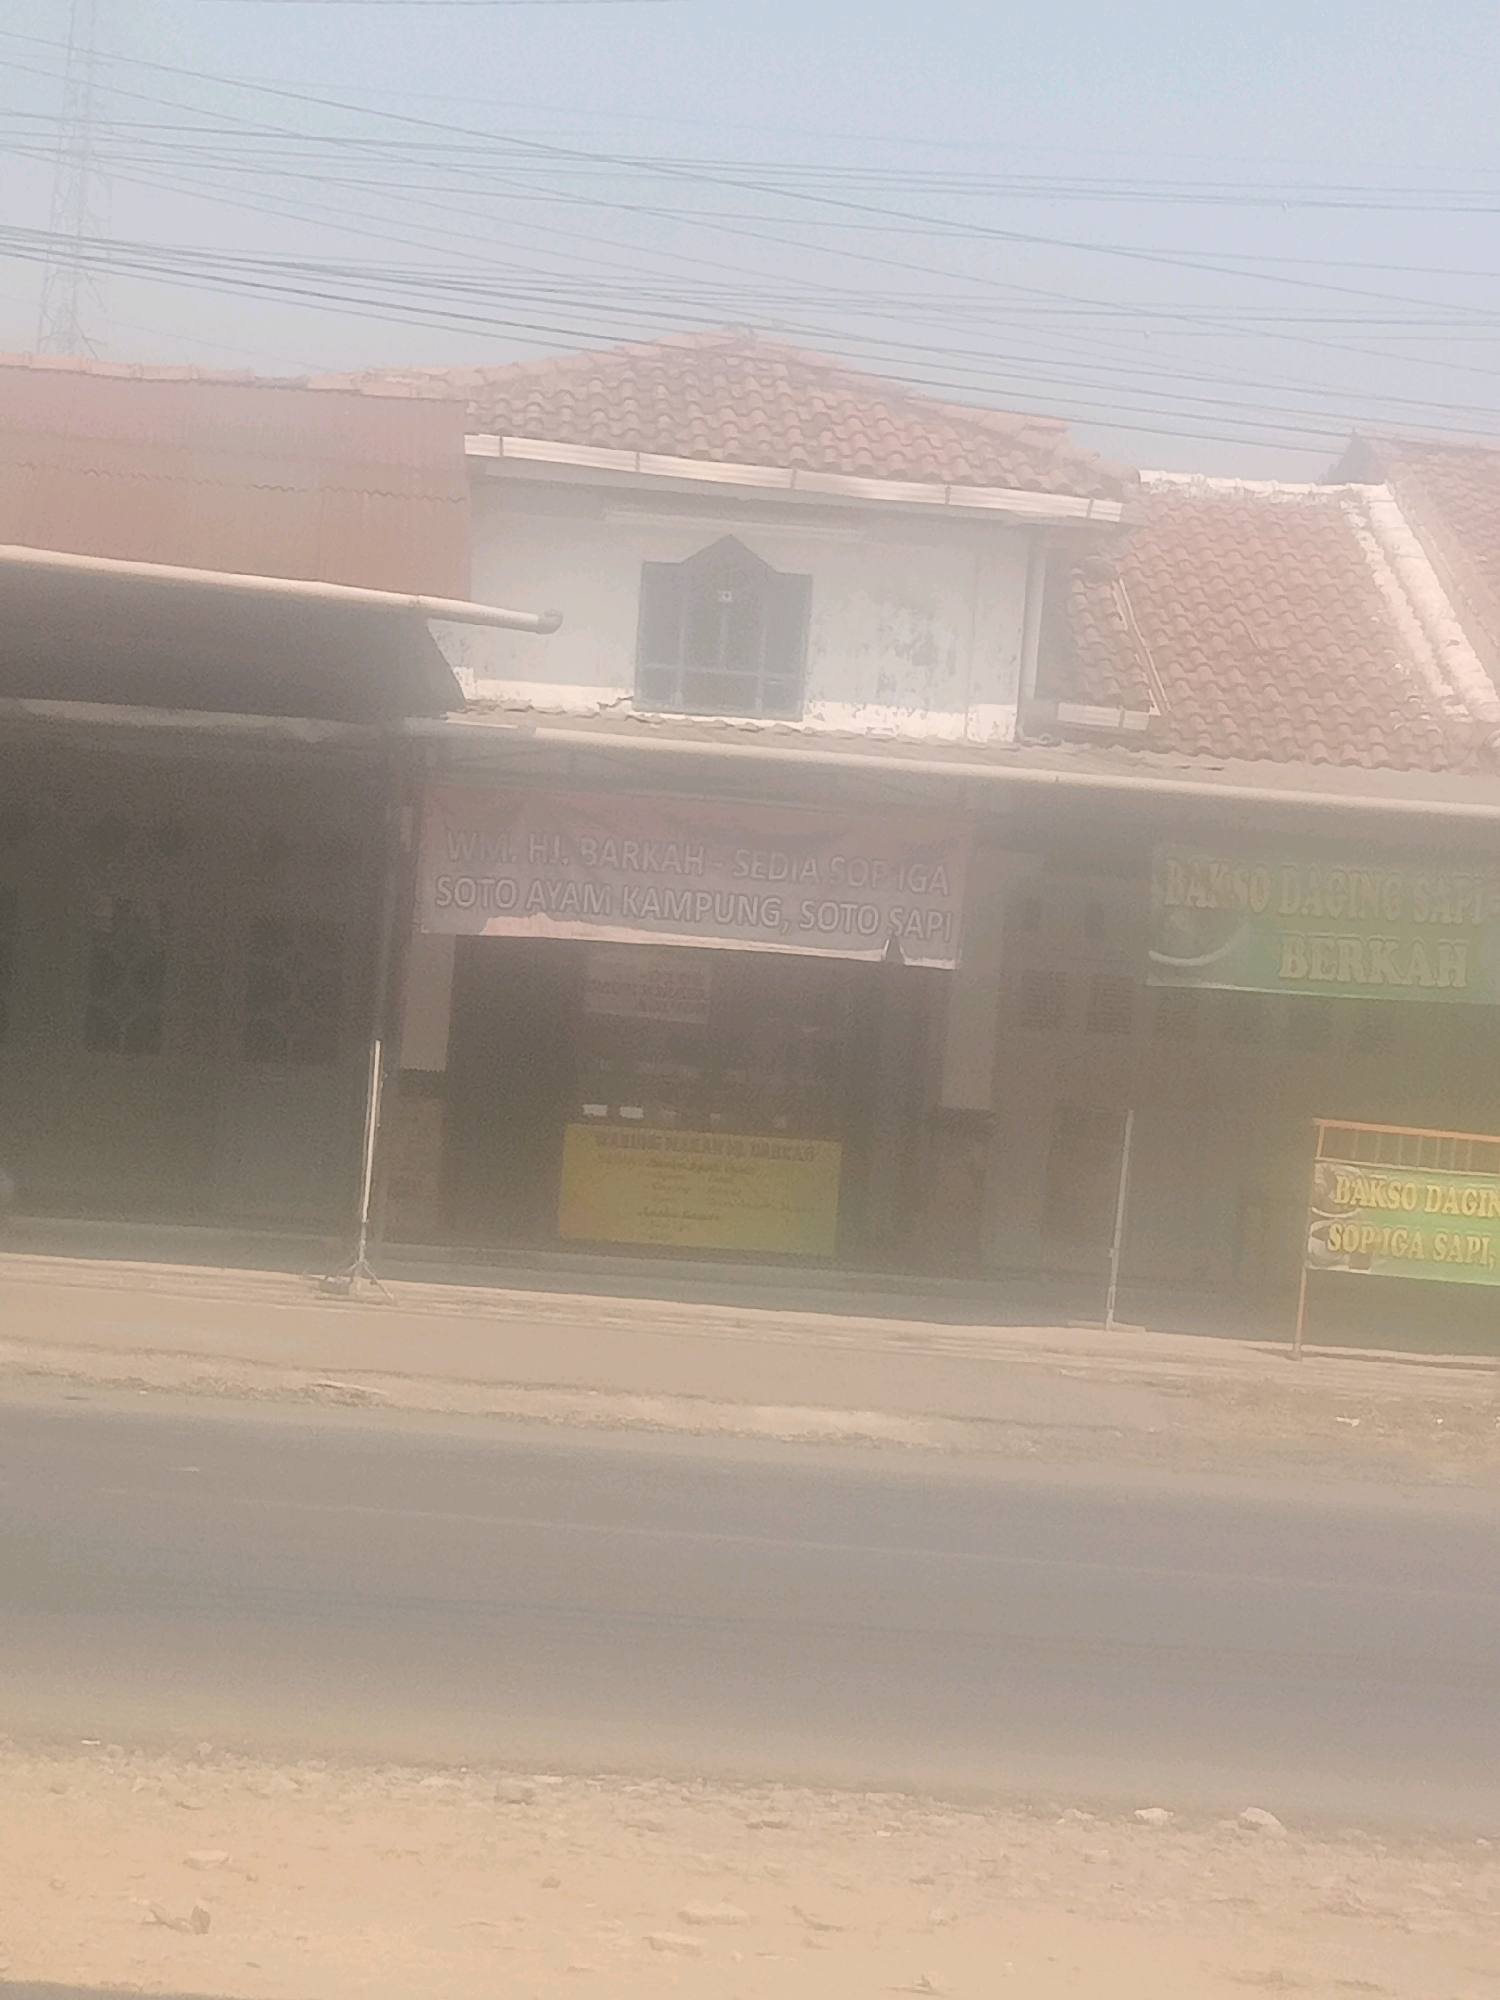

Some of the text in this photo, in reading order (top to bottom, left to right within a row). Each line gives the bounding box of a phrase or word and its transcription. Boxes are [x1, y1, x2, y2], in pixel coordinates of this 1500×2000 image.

[581, 839, 705, 876] BARKAH
[733, 849, 819, 883] SEDIA
[897, 861, 950, 896] IGA
[1278, 864, 1404, 922] DAGING
[435, 875, 954, 943] SOTO AYAM KAMPUNG, SOTO SAPI
[1278, 934, 1469, 987] BERKAH
[1334, 1175, 1418, 1211] BAKSO
[1328, 1223, 1495, 1272] SOP IGA SAPI,
